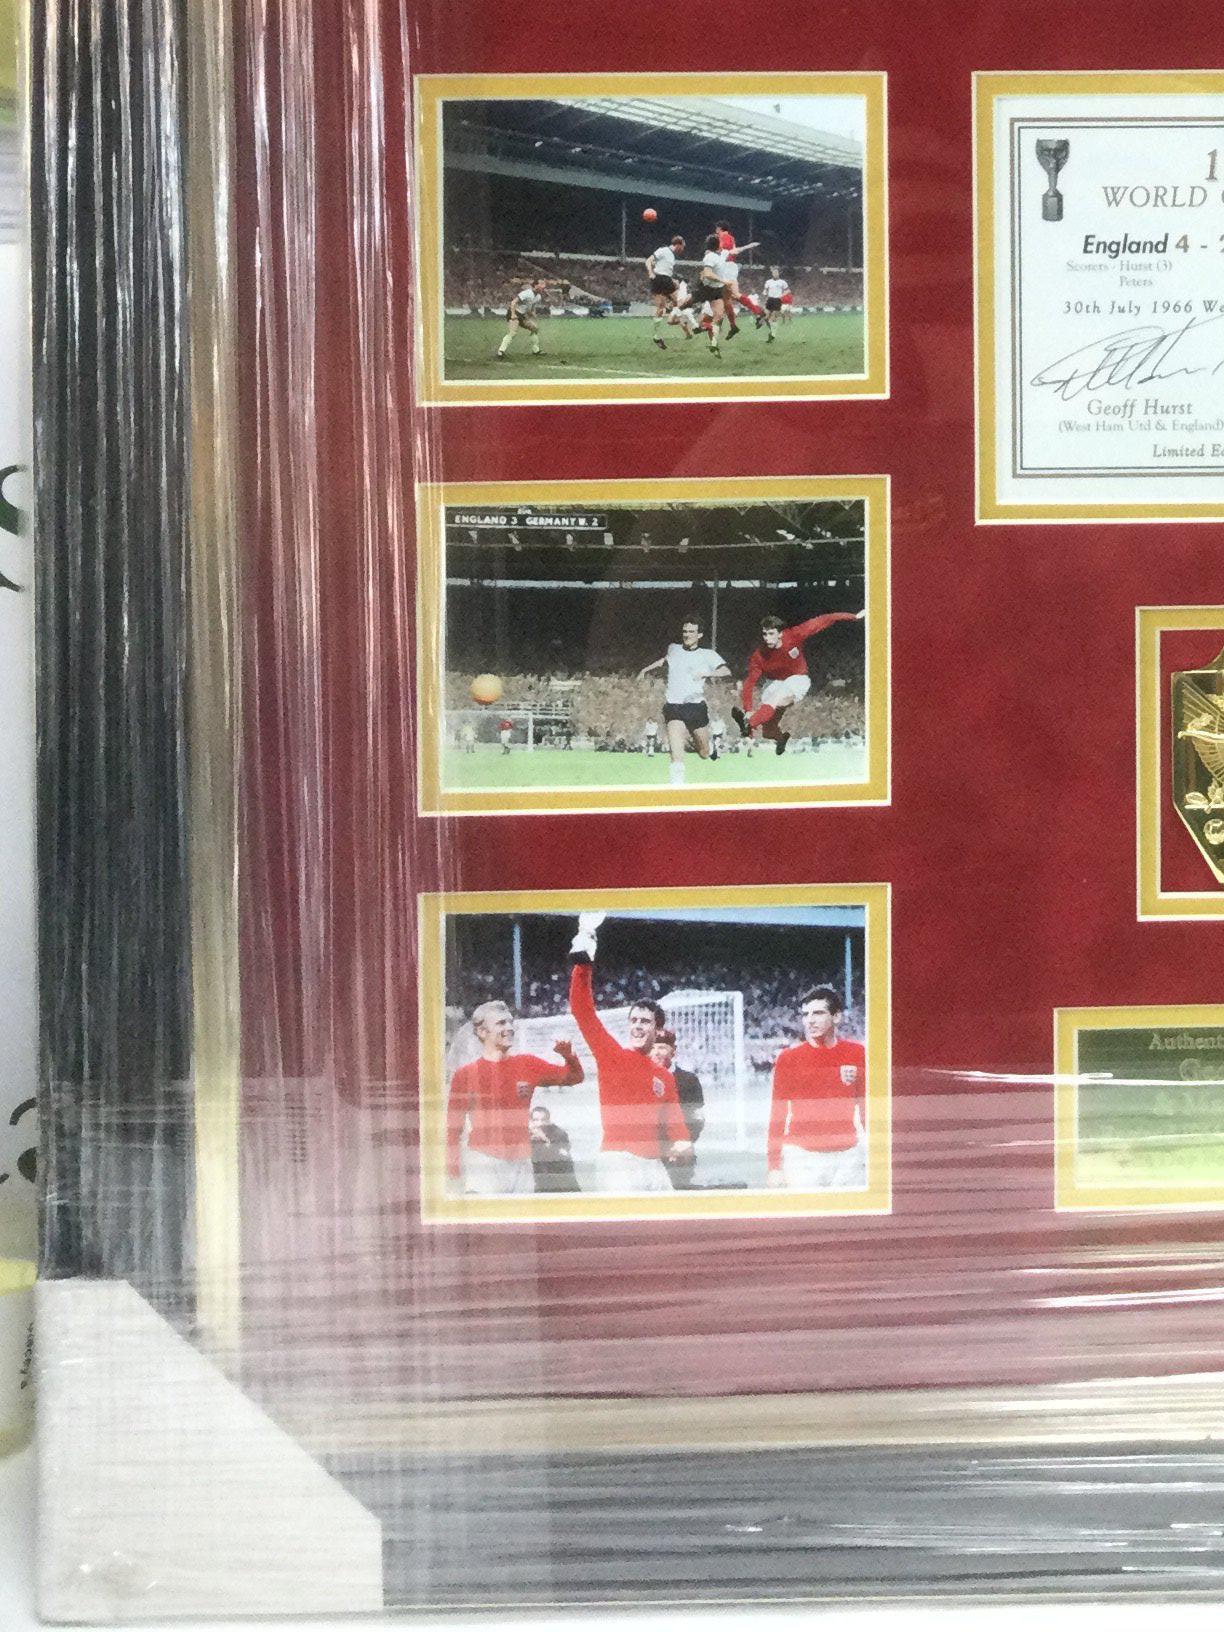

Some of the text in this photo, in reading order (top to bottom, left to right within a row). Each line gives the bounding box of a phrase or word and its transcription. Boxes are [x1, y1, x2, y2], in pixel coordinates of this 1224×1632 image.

[1102, 185, 1208, 208] WORLD
[1082, 232, 1169, 260] England
[1174, 234, 1190, 254] 4
[1066, 260, 1109, 272] Scorers
[1119, 259, 1153, 272] Hurst
[1156, 259, 1173, 273] (3)
[1119, 275, 1154, 288] Peters
[1063, 300, 1101, 314] 30th
[1109, 300, 1141, 316] July
[1152, 299, 1193, 314] 1966
[1087, 398, 1193, 419] Geoff Hurst
[1058, 418, 1224, 435] (West Ham Utd & England)
[1152, 443, 1206, 458] Limited
[455, 515, 507, 525] ENGLAND
[511, 517, 518, 525] 3
[525, 516, 576, 526] GERMANY
[592, 517, 599, 527] 2
